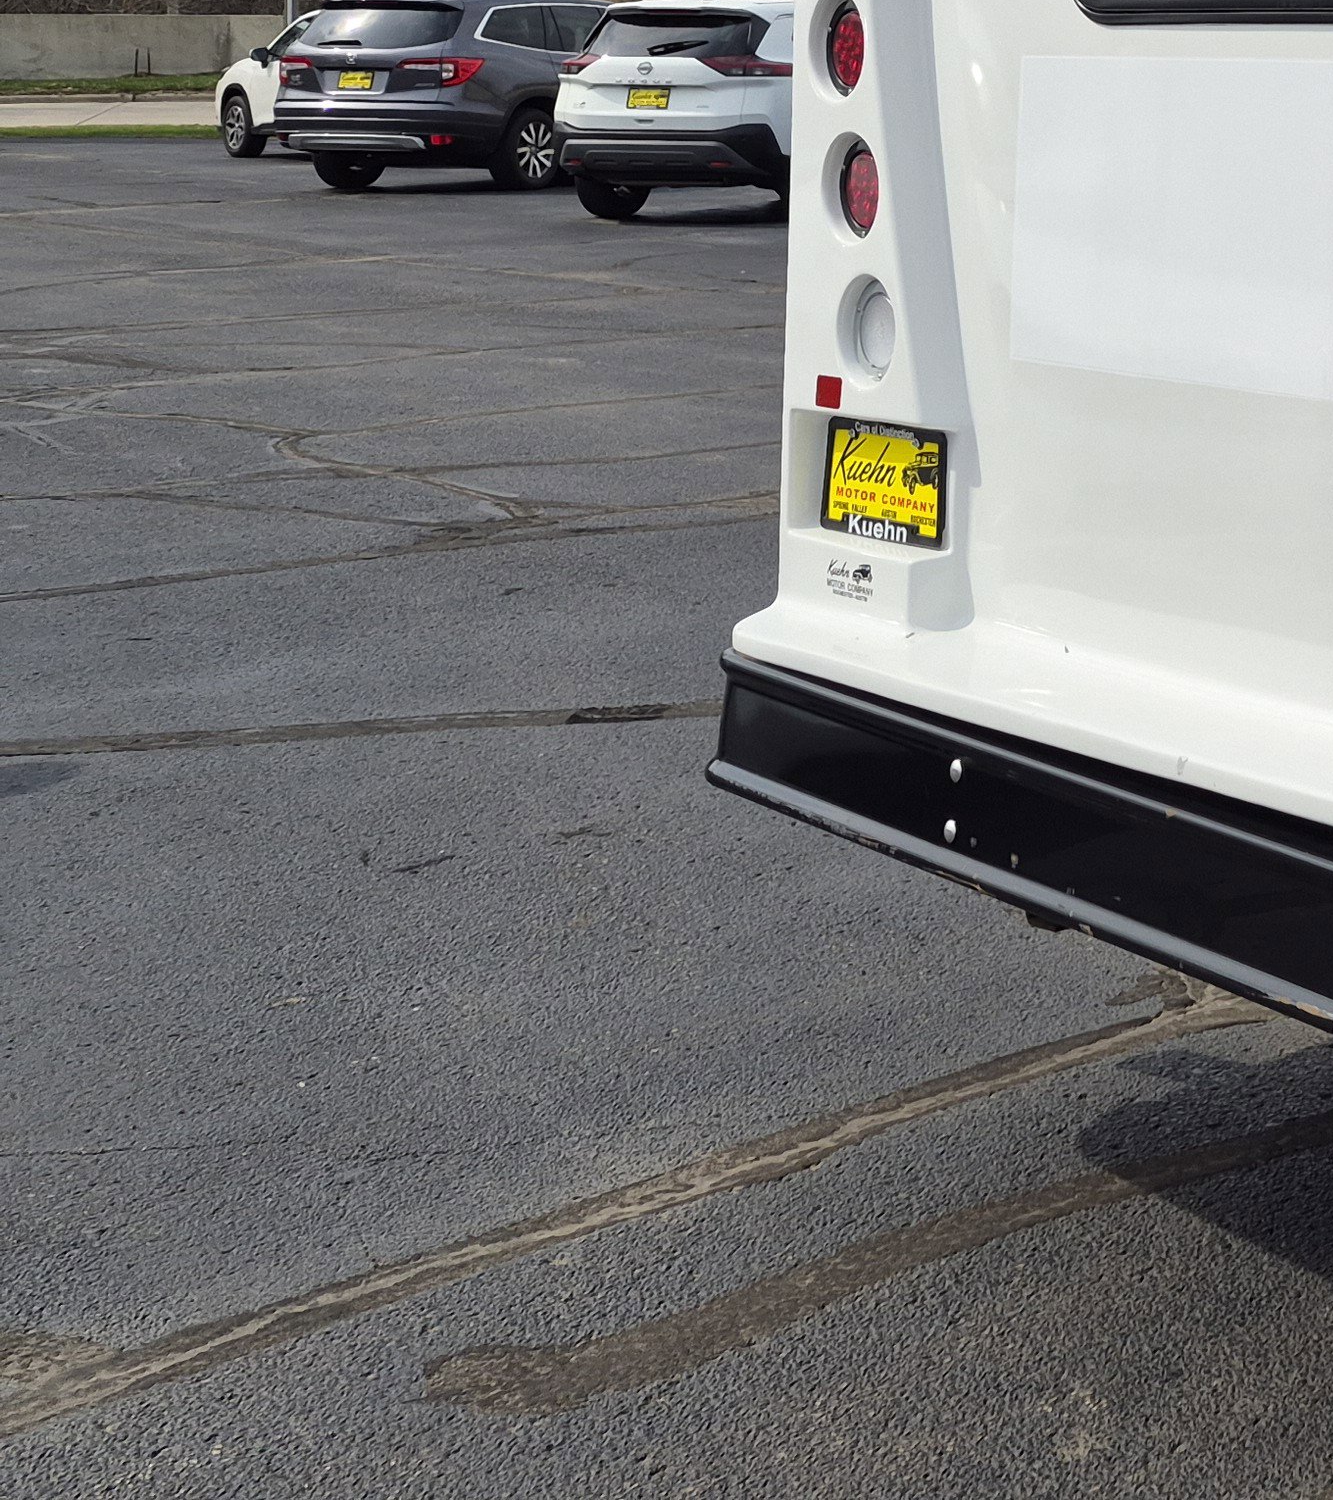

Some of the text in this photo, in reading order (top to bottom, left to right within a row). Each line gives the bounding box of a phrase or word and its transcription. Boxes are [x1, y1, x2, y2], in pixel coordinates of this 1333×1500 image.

[834, 438, 896, 487] Kuehn
[835, 486, 935, 513] MOTOR COMPANY
[848, 514, 908, 543] Kuehn
